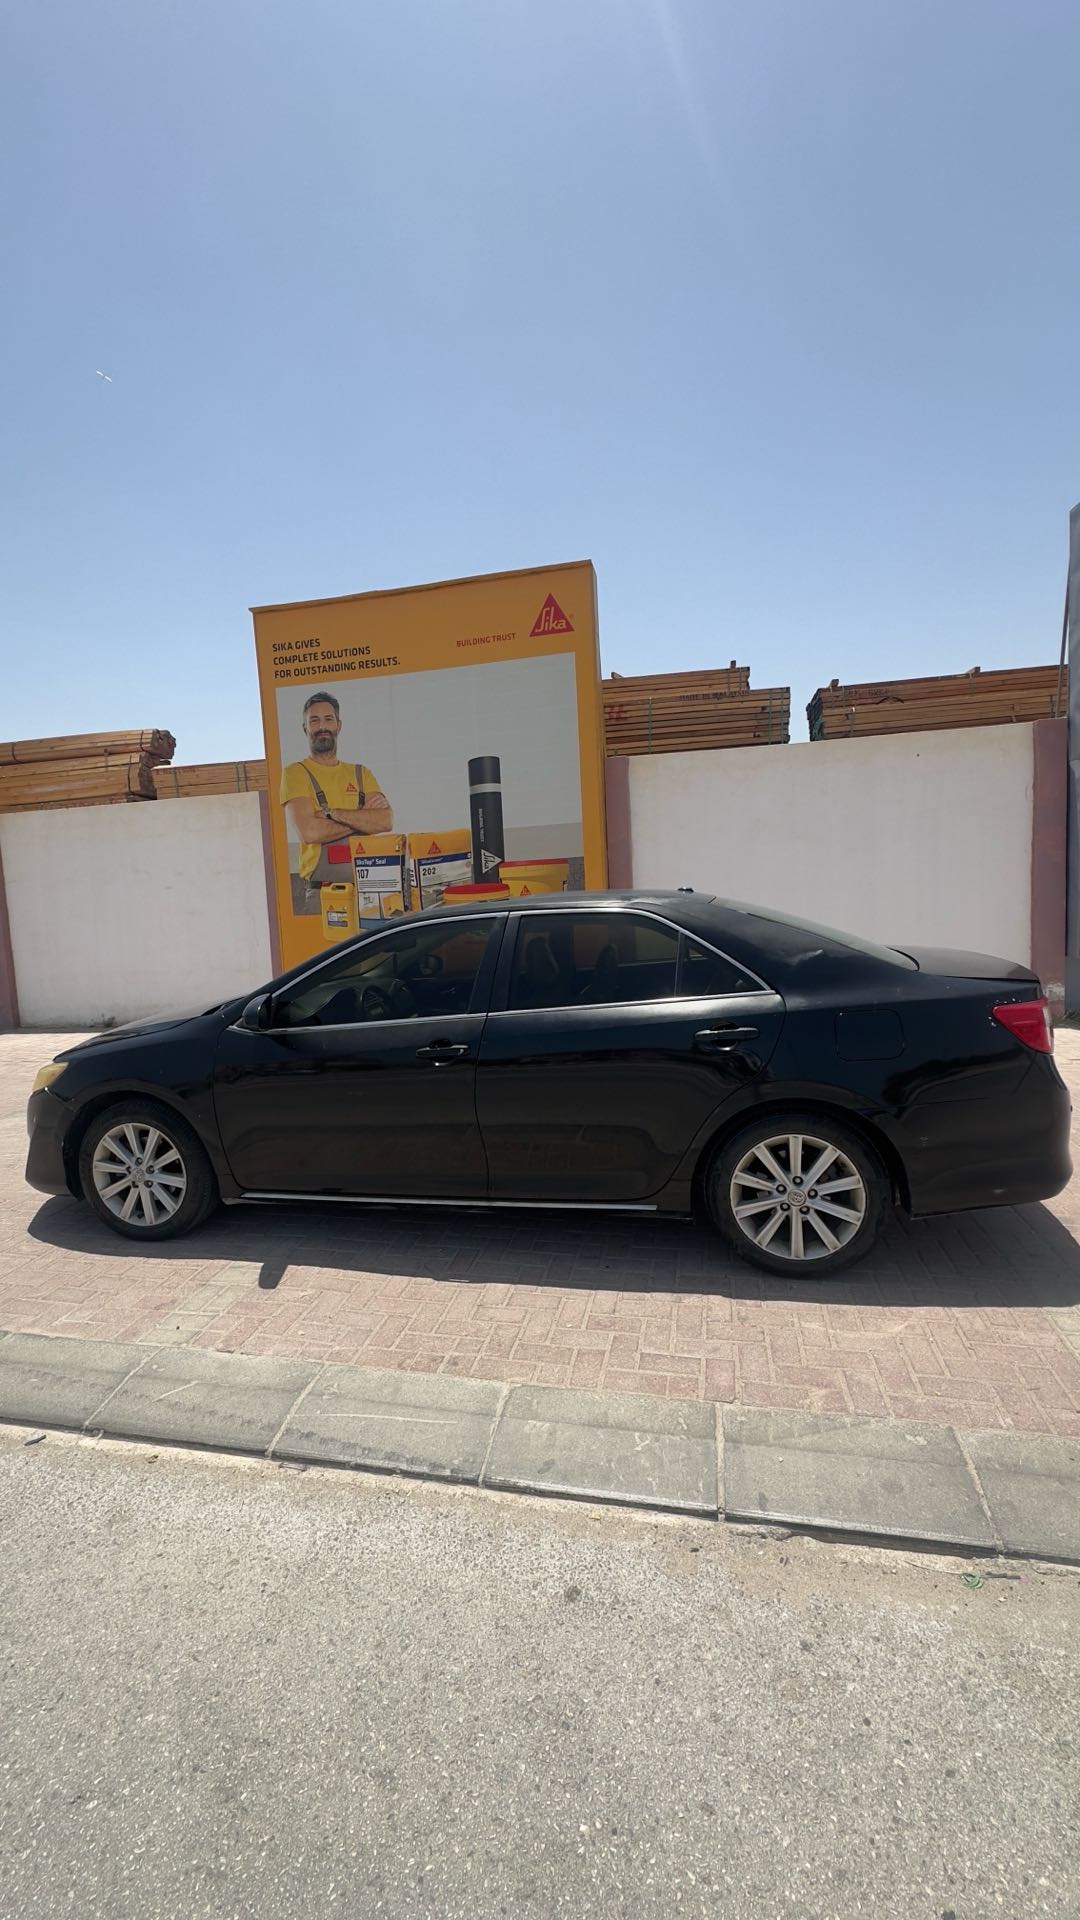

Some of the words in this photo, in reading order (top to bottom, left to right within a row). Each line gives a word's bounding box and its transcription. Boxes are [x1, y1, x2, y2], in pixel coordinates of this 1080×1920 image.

[535, 606, 567, 632] Sika
[272, 642, 293, 653] SIKA
[295, 638, 321, 650] GIVES
[456, 637, 491, 648] BUILDING
[493, 632, 517, 642] TRUST
[273, 652, 319, 666] COMPLETE
[320, 646, 371, 661] SOLUTIONS
[274, 670, 292, 679] FOR
[294, 661, 356, 677] OUTSTANDING
[358, 656, 401, 670] RESULTS.
[483, 852, 496, 870] Sika
[357, 868, 369, 880] 107
[422, 867, 436, 876] 202
